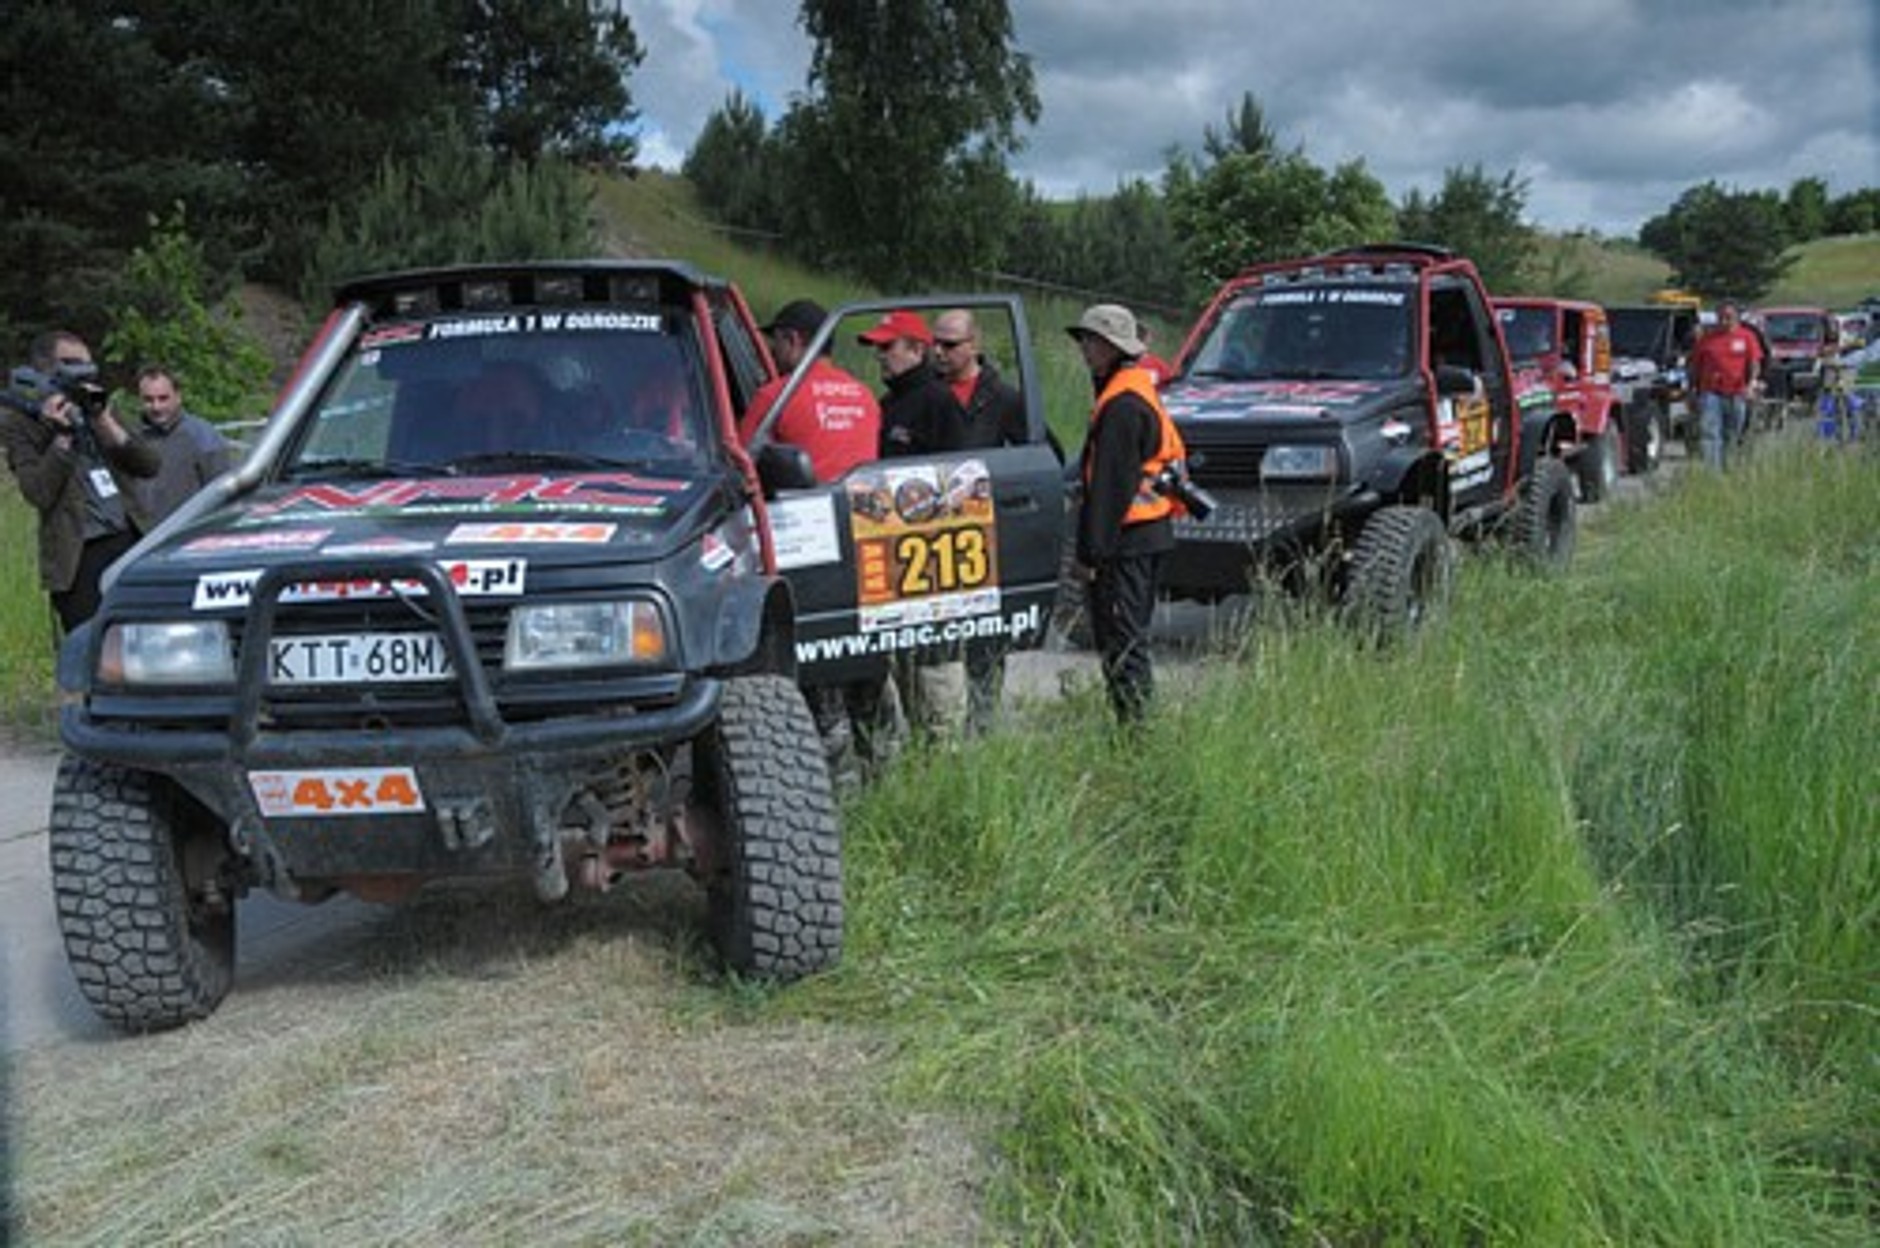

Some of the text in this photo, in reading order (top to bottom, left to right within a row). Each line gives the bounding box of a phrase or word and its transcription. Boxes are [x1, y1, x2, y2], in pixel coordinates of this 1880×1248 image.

[429, 316, 519, 339] FORMULA
[526, 314, 536, 331] 1
[540, 314, 562, 329] W
[898, 526, 988, 596] 213
[795, 604, 1039, 664] www.nac.com.pl
[271, 639, 351, 679] KTT
[293, 774, 418, 810] 4x4
